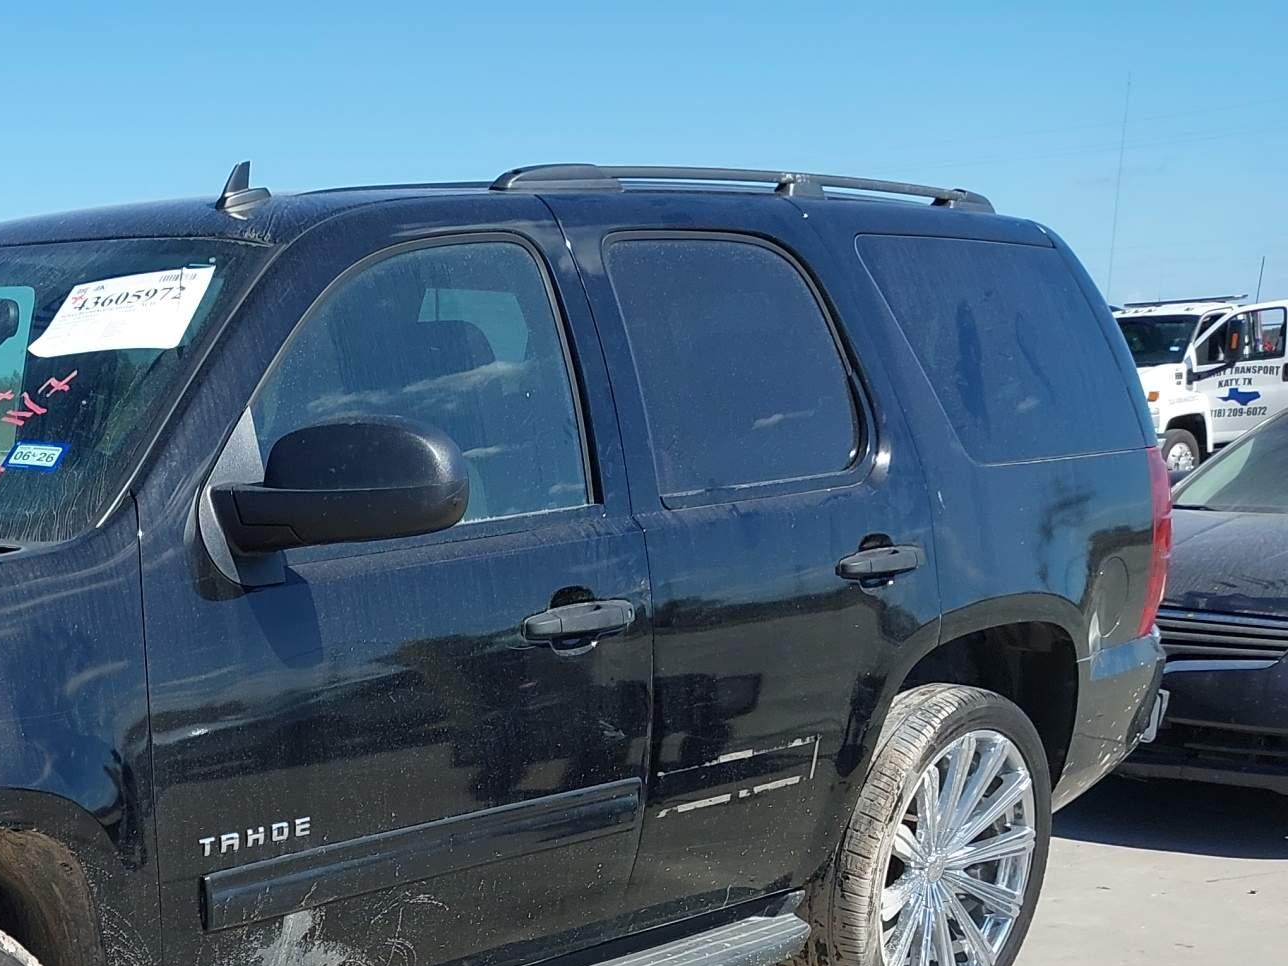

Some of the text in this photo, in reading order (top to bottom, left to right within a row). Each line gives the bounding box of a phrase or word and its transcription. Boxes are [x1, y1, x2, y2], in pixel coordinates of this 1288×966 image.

[74, 286, 186, 312] 43605972
[1230, 366, 1280, 376] TRANSPORT
[1242, 377, 1253, 386] TX
[1227, 406, 1267, 417] 209-6072
[14, 450, 56, 463] 06 26
[198, 816, 311, 857] TAHOE
